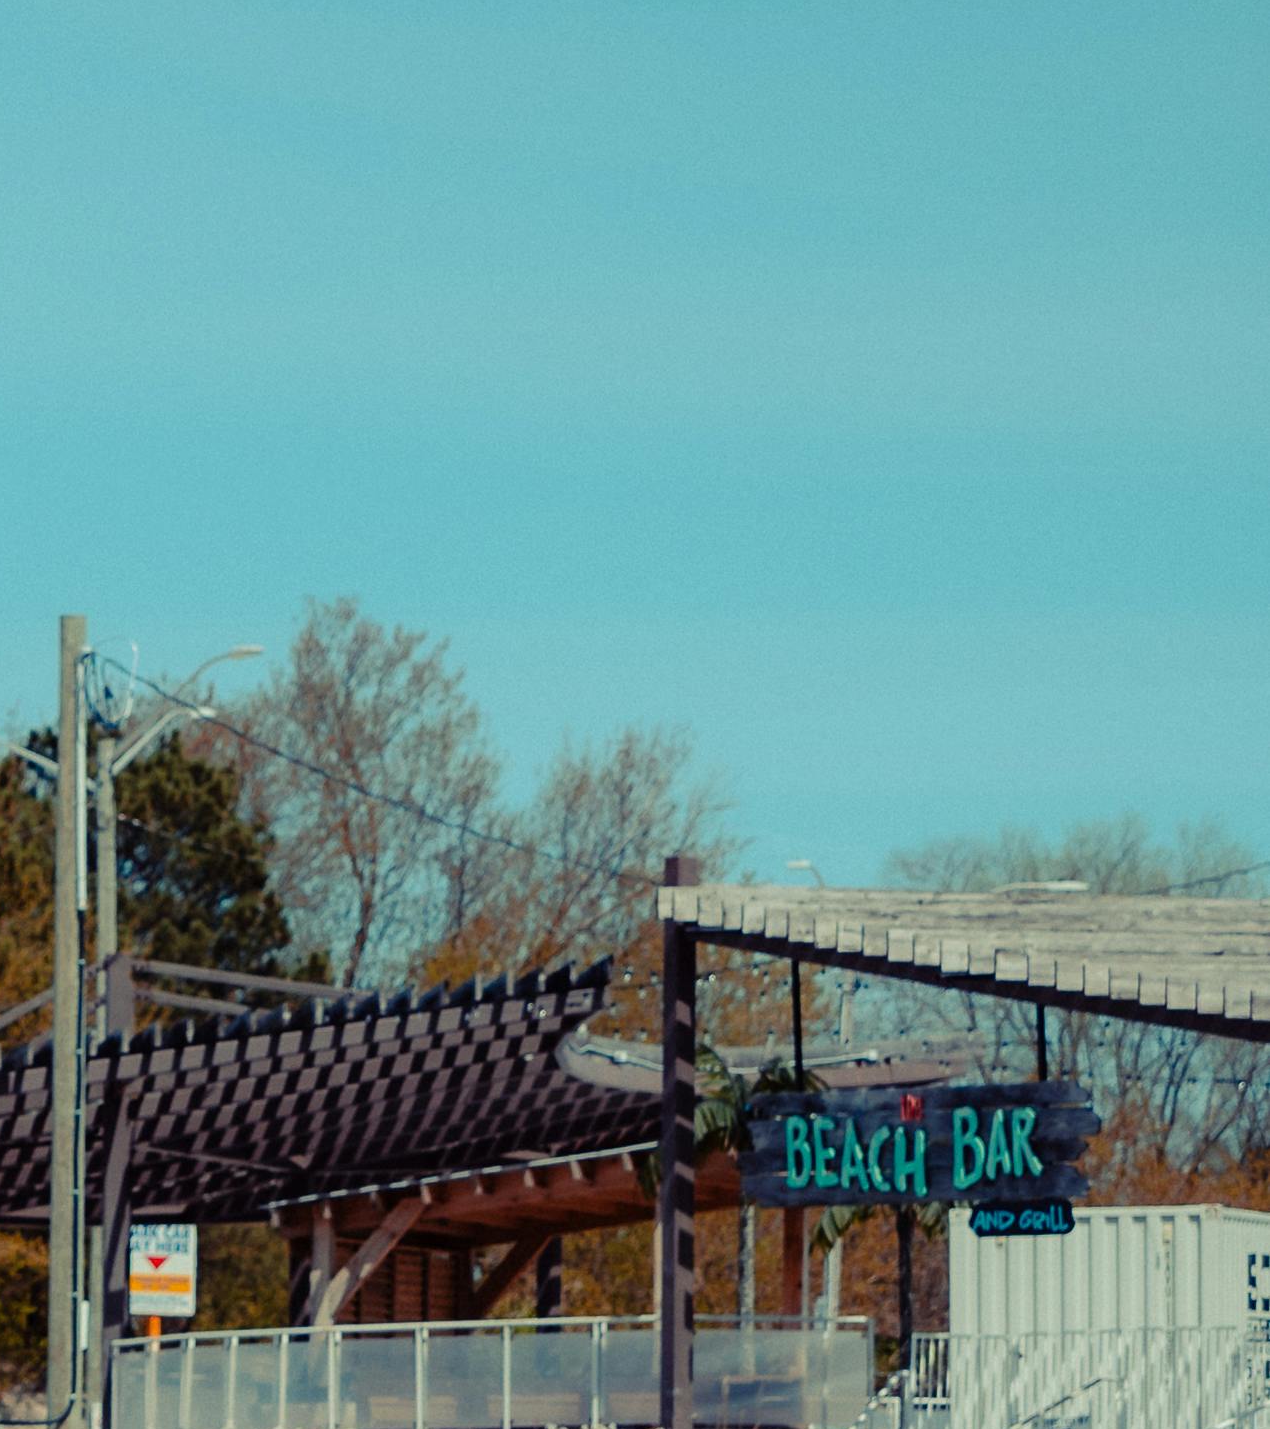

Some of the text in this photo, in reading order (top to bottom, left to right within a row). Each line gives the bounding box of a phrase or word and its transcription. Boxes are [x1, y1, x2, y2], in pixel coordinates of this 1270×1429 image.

[785, 1106, 1044, 1197] BEACH BAR
[972, 1209, 1016, 1231] AND
